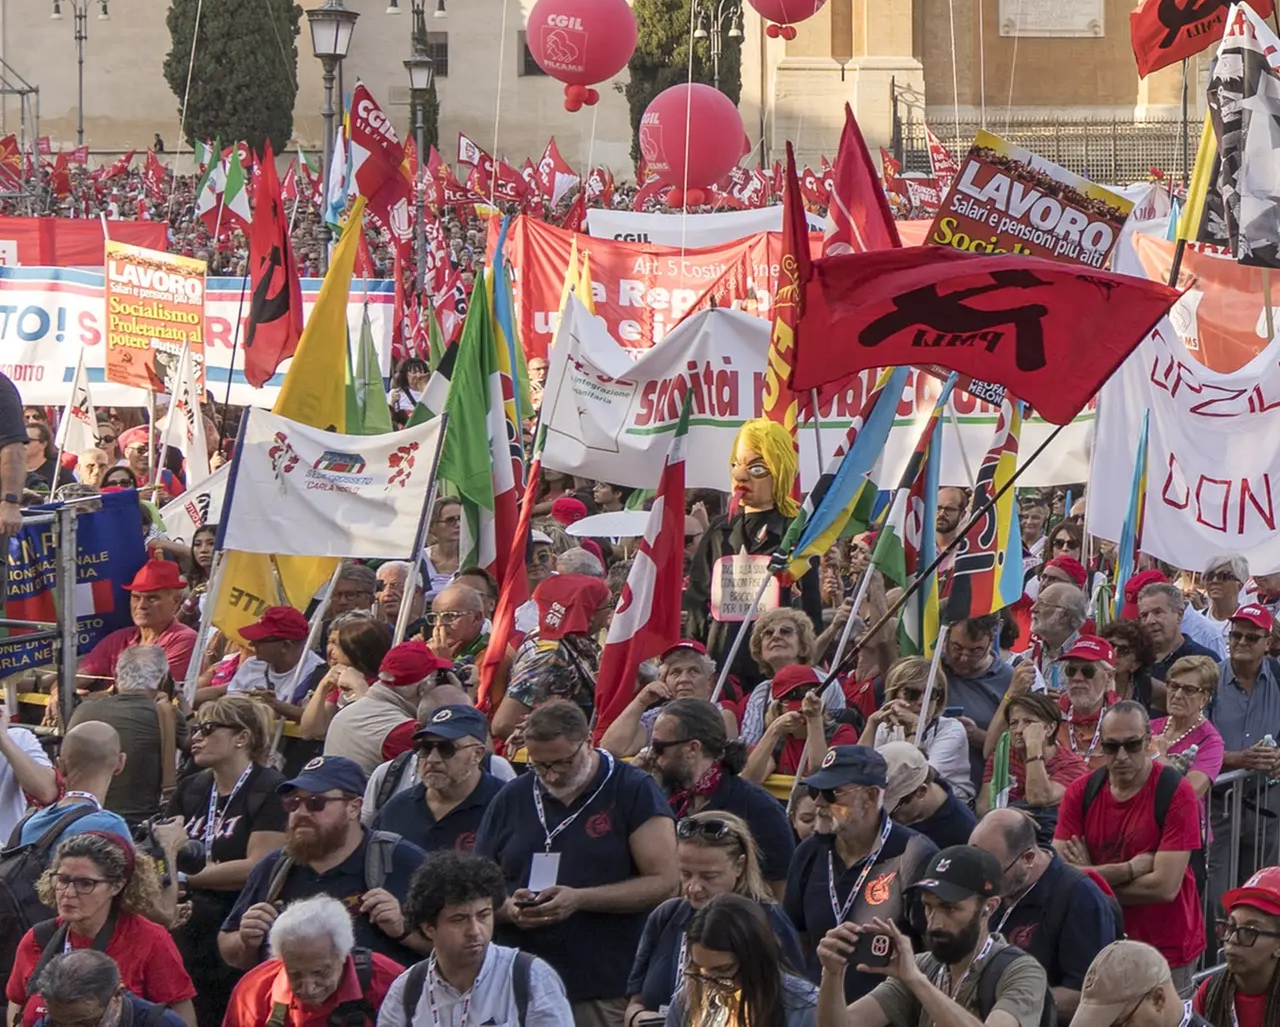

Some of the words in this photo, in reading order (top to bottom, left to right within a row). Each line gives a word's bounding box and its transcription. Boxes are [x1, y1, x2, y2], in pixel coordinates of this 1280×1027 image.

[546, 13, 584, 31] CGIL
[356, 98, 399, 144] CGIL
[957, 159, 1114, 259] LAVORO
[950, 194, 989, 222] Salari
[989, 216, 999, 228] e
[998, 218, 1058, 251] pensioni
[1058, 235, 1081, 260] più
[1080, 248, 1105, 268] alti
[107, 260, 203, 296] LAVORO
[633, 258, 663, 277] Art.
[667, 260, 677, 276] 5
[109, 282, 133, 295] Salari
[109, 297, 200, 324] Socialismo
[109, 315, 187, 342] Proletariato
[188, 326, 203, 343] al
[109, 333, 150, 350] potere
[634, 356, 740, 427] sanità
